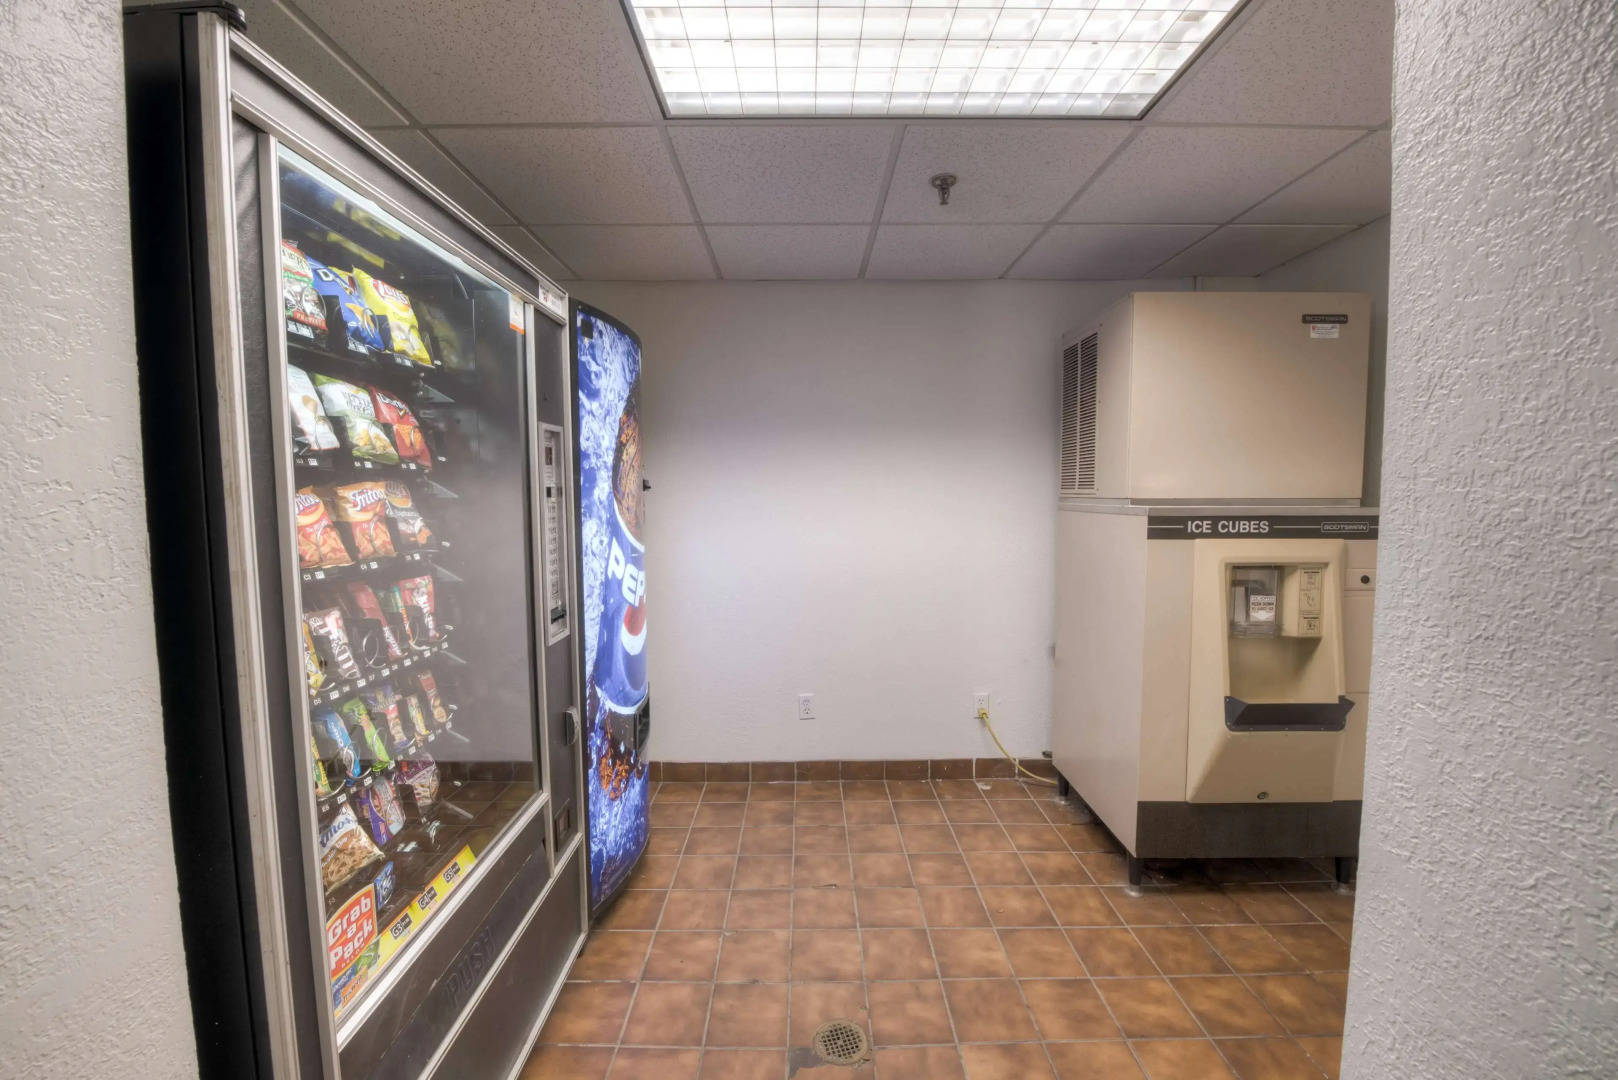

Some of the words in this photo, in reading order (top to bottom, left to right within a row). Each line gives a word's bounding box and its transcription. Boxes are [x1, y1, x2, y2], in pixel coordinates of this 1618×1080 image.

[349, 489, 385, 512] Fritos
[1187, 521, 1212, 533] ICE
[1218, 521, 1269, 533] CUBES
[1324, 523, 1367, 531] SCOTSMAN
[607, 536, 646, 607] PEP
[444, 869, 454, 881] G5
[420, 893, 430, 908] G4
[328, 896, 372, 946] Grab
[347, 922, 357, 939] a
[392, 923, 402, 937] G3
[330, 918, 373, 971] Pack
[446, 924, 496, 1008] PUSH
